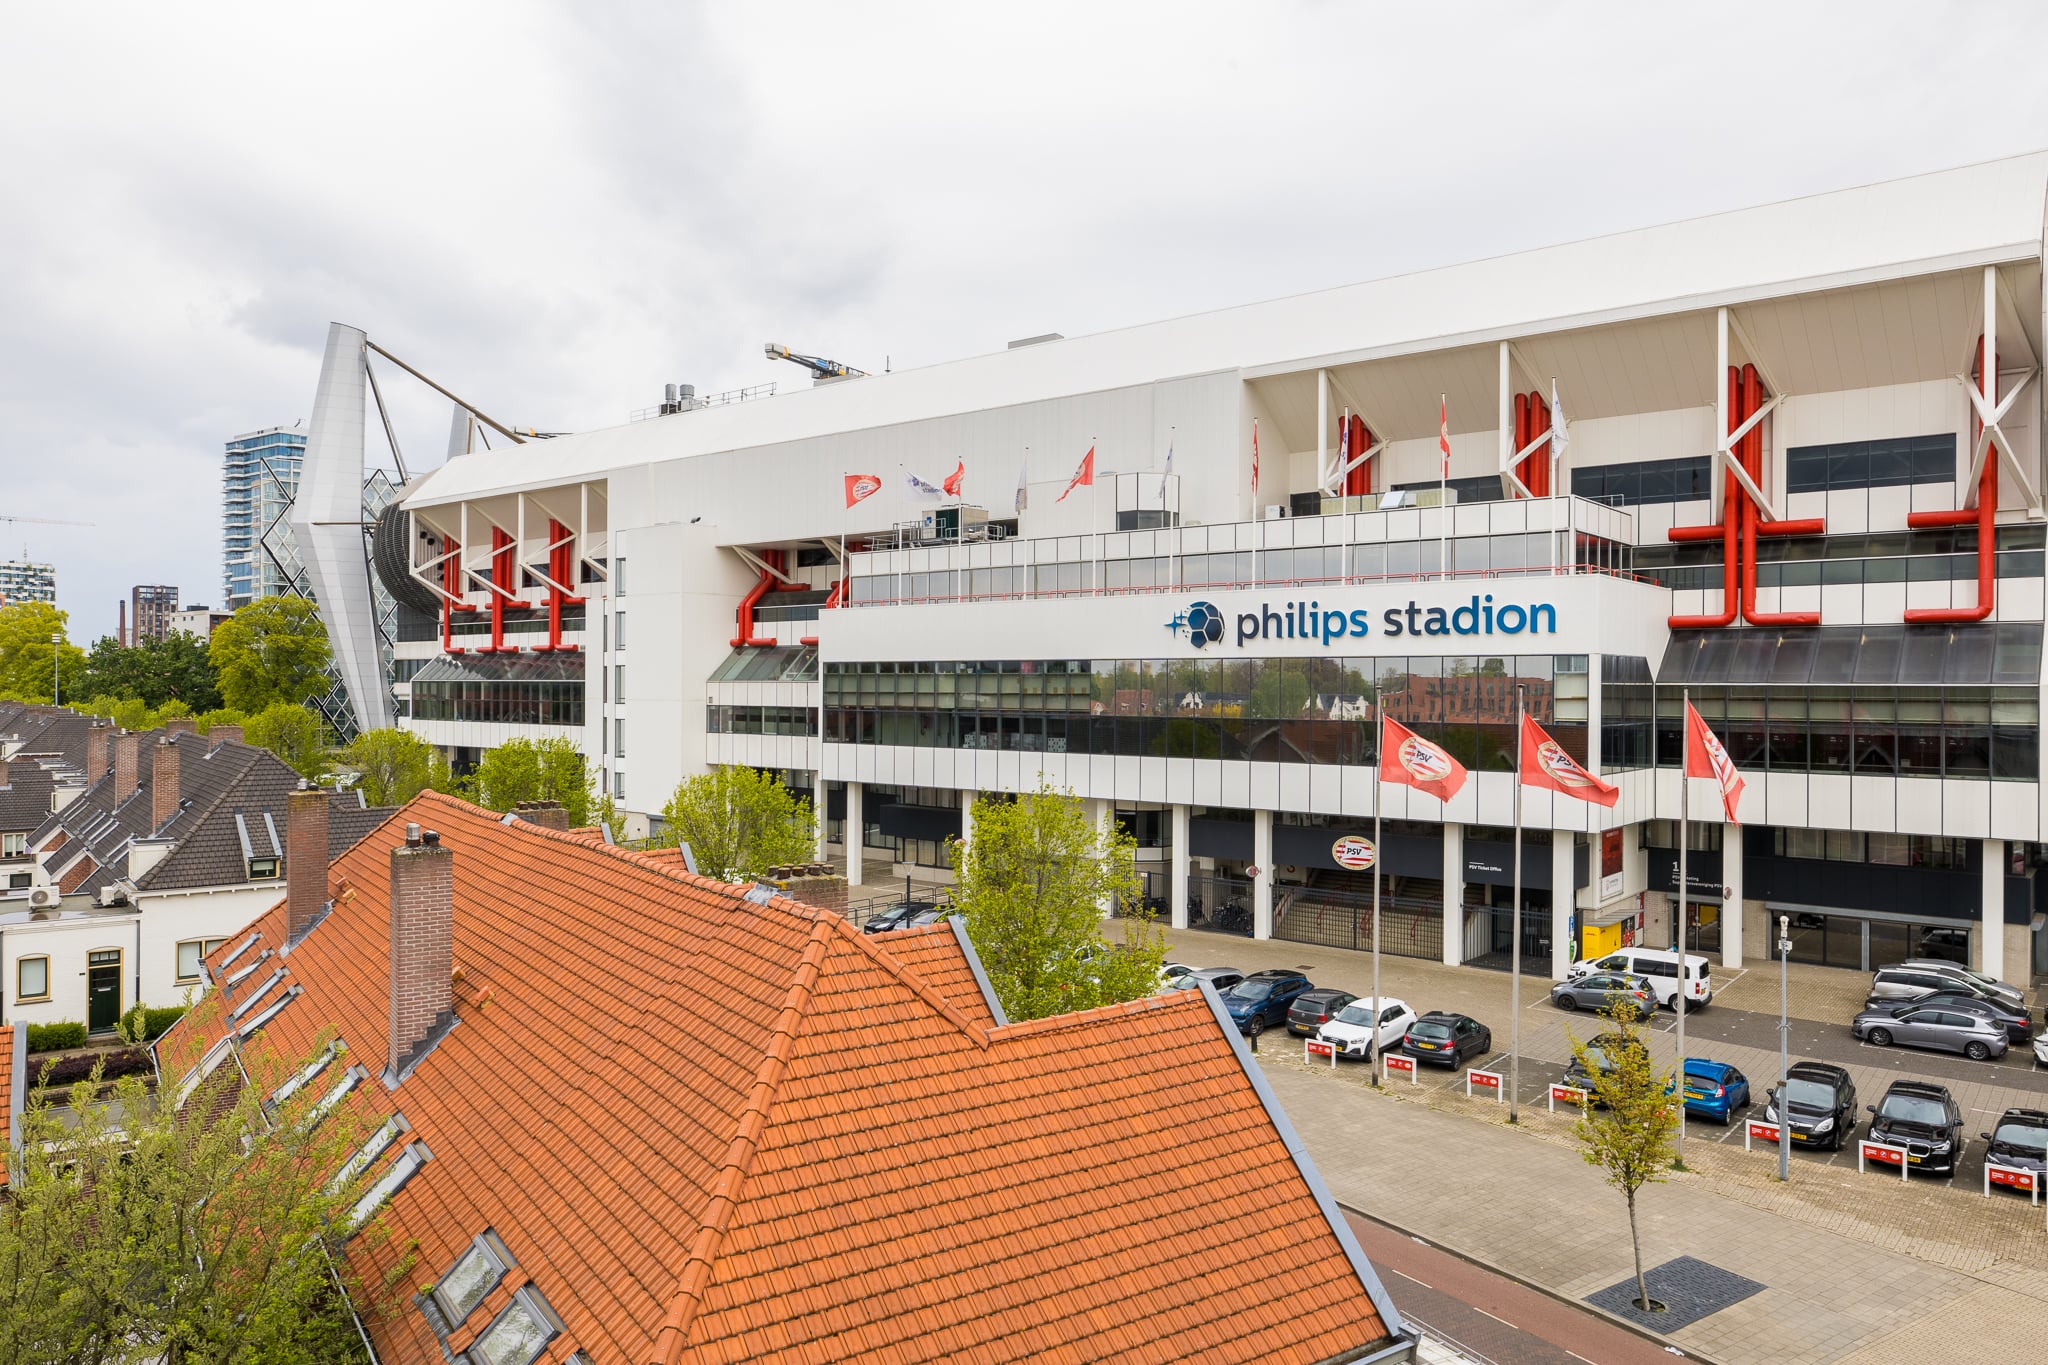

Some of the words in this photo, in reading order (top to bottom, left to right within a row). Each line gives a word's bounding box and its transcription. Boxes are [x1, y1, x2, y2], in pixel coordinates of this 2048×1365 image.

[1237, 601, 1369, 647] philips
[1383, 594, 1557, 636] stadion
[1416, 750, 1432, 762] PSV
[1346, 847, 1362, 856] PSV
